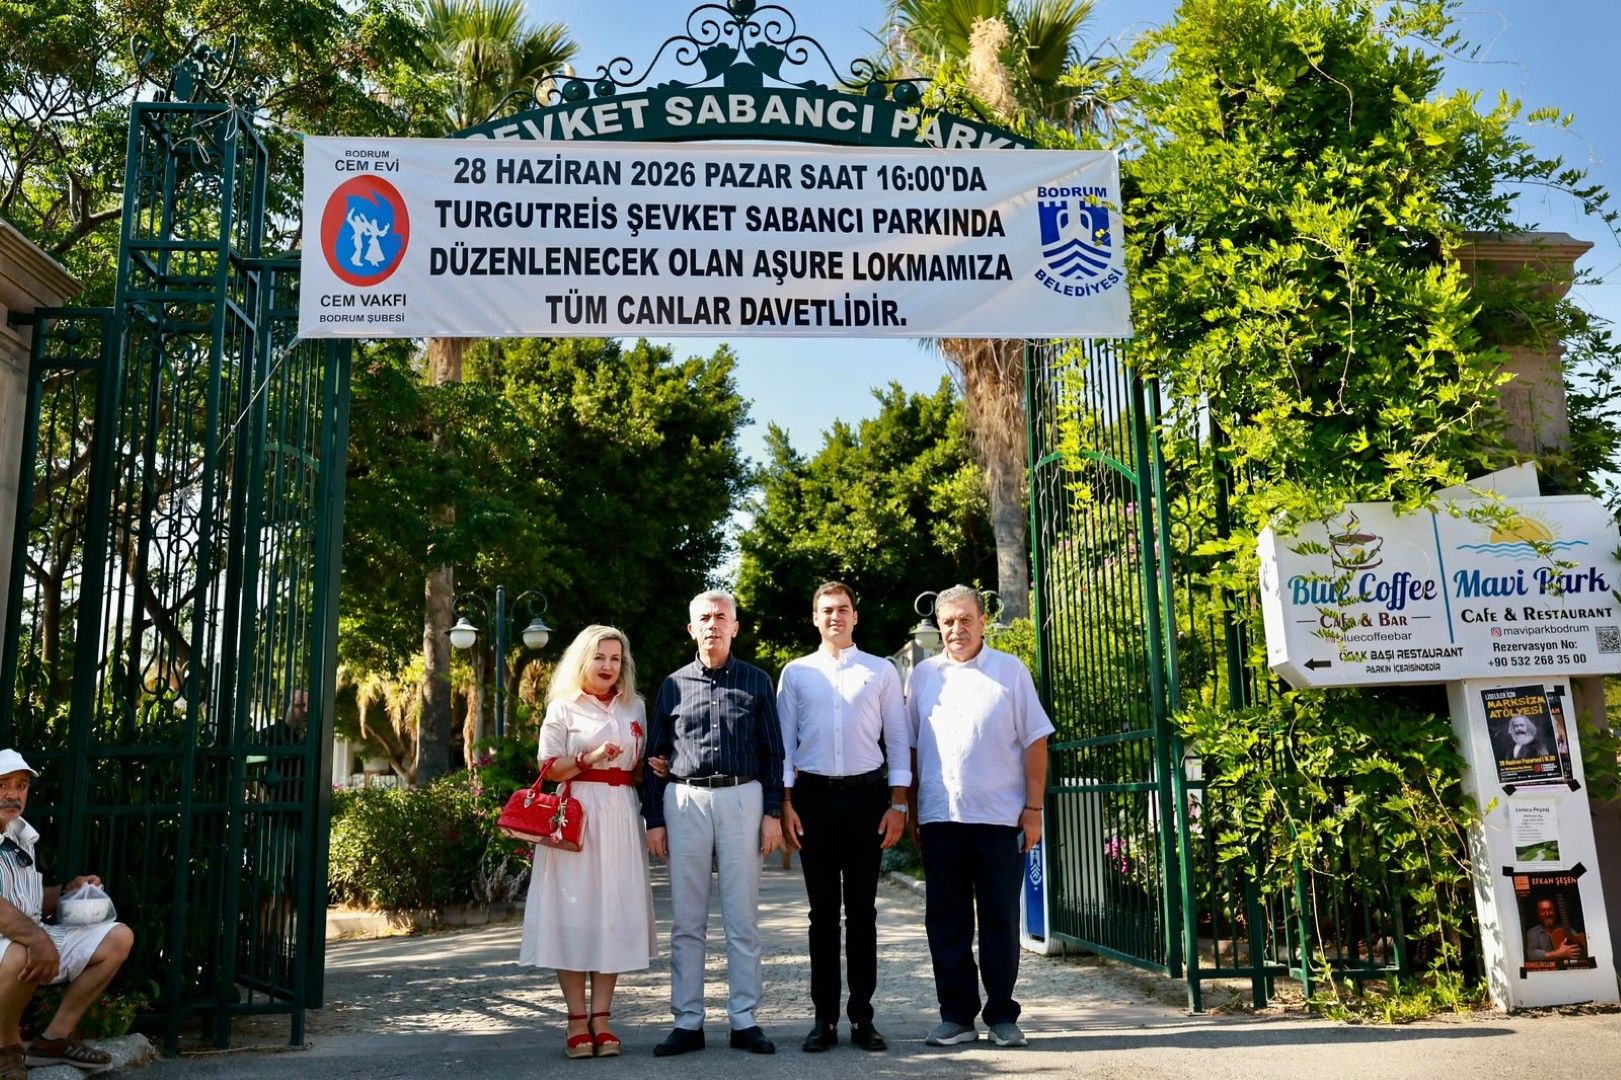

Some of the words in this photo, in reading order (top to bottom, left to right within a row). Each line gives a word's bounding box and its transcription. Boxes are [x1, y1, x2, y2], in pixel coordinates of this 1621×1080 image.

[466, 99, 650, 140] EVKET
[664, 94, 875, 134] SABANCI
[891, 109, 1025, 149] PARK
[345, 150, 390, 158] BODRUM
[335, 159, 369, 172] CEM
[374, 158, 400, 172] EVİ
[453, 157, 487, 184] 28
[496, 153, 622, 186] HAZİRAN
[630, 160, 696, 187] 2026
[705, 162, 793, 189] PAZAR
[800, 164, 868, 190] SAAT
[876, 165, 988, 192] 16:00'DA
[1037, 186, 1107, 198] BODRUM
[434, 196, 618, 229] TURGUTREİS
[626, 203, 737, 238] ŞEVKET
[745, 205, 864, 233] SABANCI
[872, 208, 1006, 238] PARKINDA
[429, 241, 660, 277] DÜZENLENECEK
[668, 248, 743, 277] OLAN
[752, 249, 844, 286] AŞURE
[852, 251, 1014, 282] LOKMAMIZA
[1034, 267, 1124, 297] BELEDİYESİ
[320, 294, 356, 307] CEM
[360, 293, 407, 307] VAKFI
[545, 288, 607, 325] TÜM
[617, 295, 732, 325] CANLAR
[740, 292, 907, 327] DAVETLİDİR.
[319, 314, 365, 323] BODRUM
[367, 312, 405, 324] ŞUBESİ
[1453, 568, 1529, 598] Mavi
[1533, 566, 1611, 596] Park
[1287, 574, 1350, 606] Blue
[1359, 571, 1438, 611] Coffee
[1361, 612, 1373, 627] &
[1504, 606, 1518, 622] &
[1503, 624, 1590, 636] maviparkbodrum
[1492, 640, 1558, 653] Rezervasyon
[1561, 639, 1578, 650] No:
[1370, 650, 1395, 662] BAŞI
[1397, 647, 1464, 659] RESTAURANT
[1488, 656, 1508, 668] +90
[1510, 655, 1531, 667] 532
[1534, 654, 1554, 666] 268
[1557, 653, 1570, 665] 35
[1573, 653, 1587, 664] 00
[1366, 665, 1392, 674] PARKIN
[1487, 695, 1546, 709] MARKSİZM
[1489, 703, 1543, 719] ATÖLYESİ
[1532, 877, 1554, 885] EFKAN
[1555, 876, 1577, 886] ŞEŞEN
